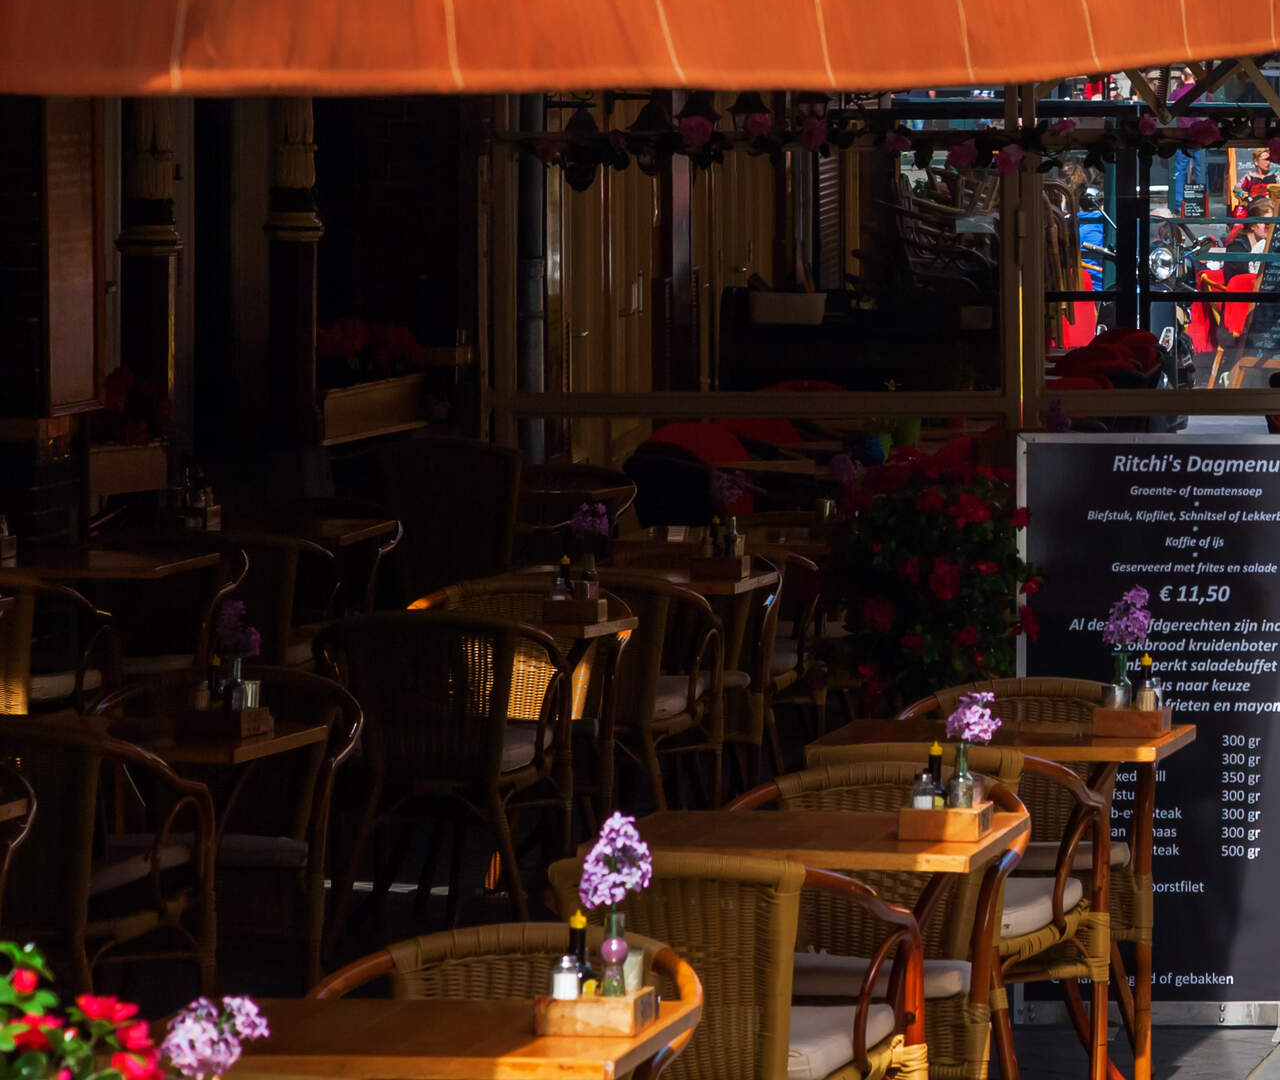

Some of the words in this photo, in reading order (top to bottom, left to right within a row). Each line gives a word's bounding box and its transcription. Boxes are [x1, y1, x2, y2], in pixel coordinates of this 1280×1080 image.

[1112, 454, 1182, 473] Ritchi's
[1186, 455, 1280, 477] Dagmenu
[1129, 485, 1177, 496] Groente-
[1179, 484, 1192, 498] of
[1193, 486, 1263, 498] tomatensoep
[1087, 510, 1133, 522] Biefstuk,
[1136, 510, 1176, 523] Kipfilet,
[1179, 510, 1226, 522] Schnitsel
[1228, 510, 1241, 523] of
[1165, 536, 1197, 549] Koffie
[1198, 536, 1212, 549] of
[1212, 536, 1225, 549] ijs
[1111, 562, 1172, 573] Geserveerd
[1174, 563, 1195, 573] met
[1195, 561, 1225, 575] frites
[1227, 565, 1240, 573] en
[1242, 562, 1278, 574] salade
[1160, 585, 1173, 602] €
[1176, 585, 1231, 605] 11,50
[1069, 619, 1084, 631] Al
[1234, 619, 1258, 633] zijn
[1114, 639, 1186, 652] Sokbrood
[1188, 638, 1279, 652] kruidenboter
[1190, 659, 1278, 674] saladebuffet
[1176, 681, 1209, 691] naar
[1211, 679, 1251, 692] keuze
[1165, 698, 1210, 714] frieten
[1213, 700, 1229, 712] en
[1221, 735, 1246, 746] 300
[1247, 736, 1262, 748] gr
[1221, 754, 1246, 765] 300
[1247, 755, 1262, 767] gr
[1221, 772, 1246, 783] 350
[1247, 773, 1262, 785] gr
[1221, 790, 1246, 801] 300
[1247, 791, 1262, 803] gr
[1221, 809, 1246, 820] 300
[1247, 810, 1262, 822] gr
[1221, 827, 1246, 838] 300
[1247, 828, 1262, 840] gr
[1152, 843, 1180, 855] teak
[1221, 845, 1246, 856] 500
[1247, 846, 1262, 858] gr
[1160, 972, 1172, 985] of
[1174, 972, 1234, 987] gebakken
